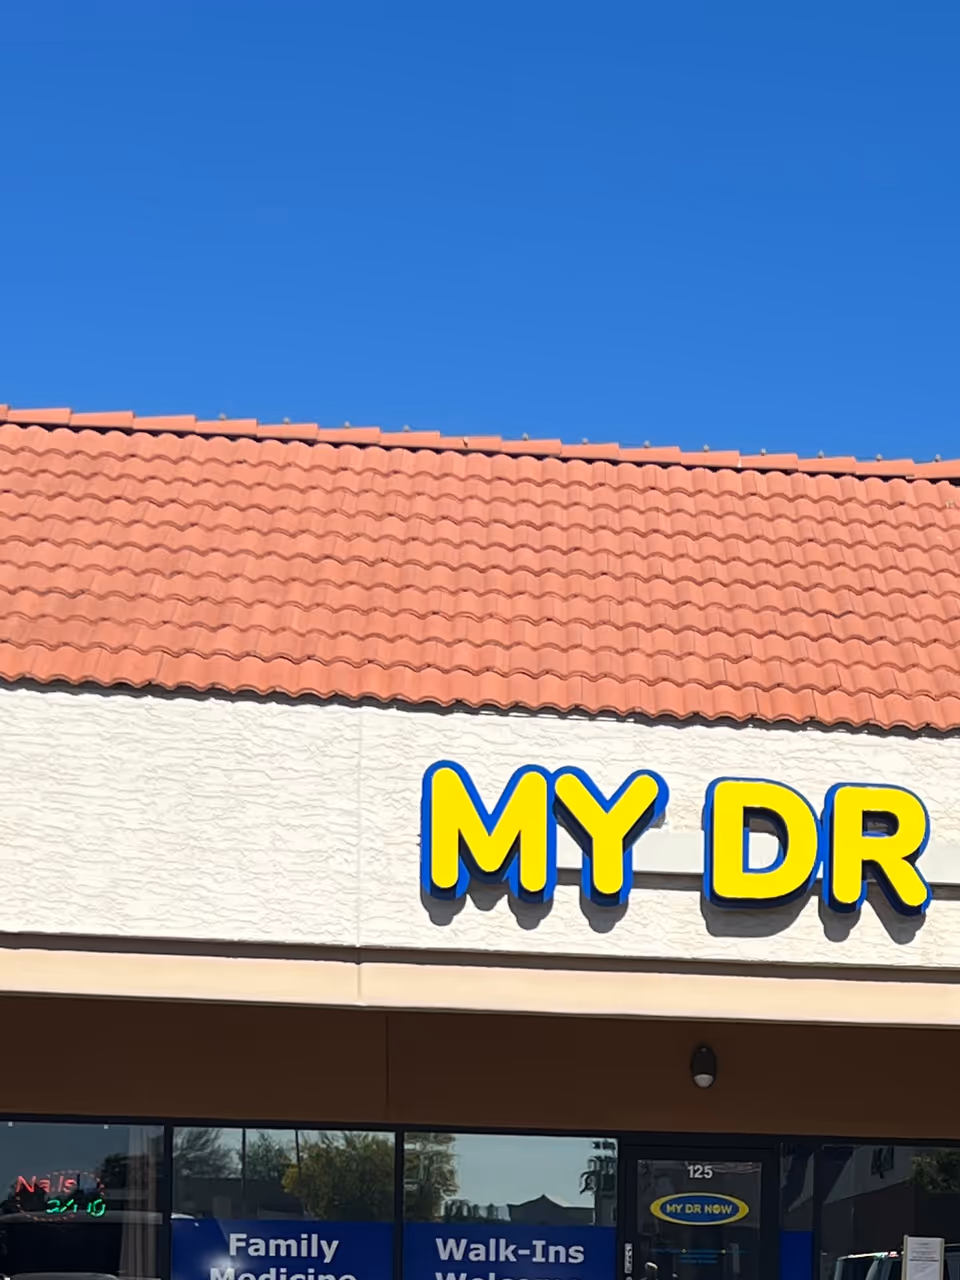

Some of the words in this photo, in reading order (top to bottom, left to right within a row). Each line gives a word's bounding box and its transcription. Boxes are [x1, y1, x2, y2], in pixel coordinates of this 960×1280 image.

[421, 760, 668, 901] MY
[704, 778, 931, 913] DR
[687, 1165, 713, 1179] 125
[15, 1175, 77, 1194] Nals
[666, 1204, 683, 1214] MY
[685, 1204, 702, 1215] DR
[704, 1205, 733, 1215] NOW
[228, 1233, 340, 1263] Family
[435, 1238, 585, 1264] Walk-Ins
